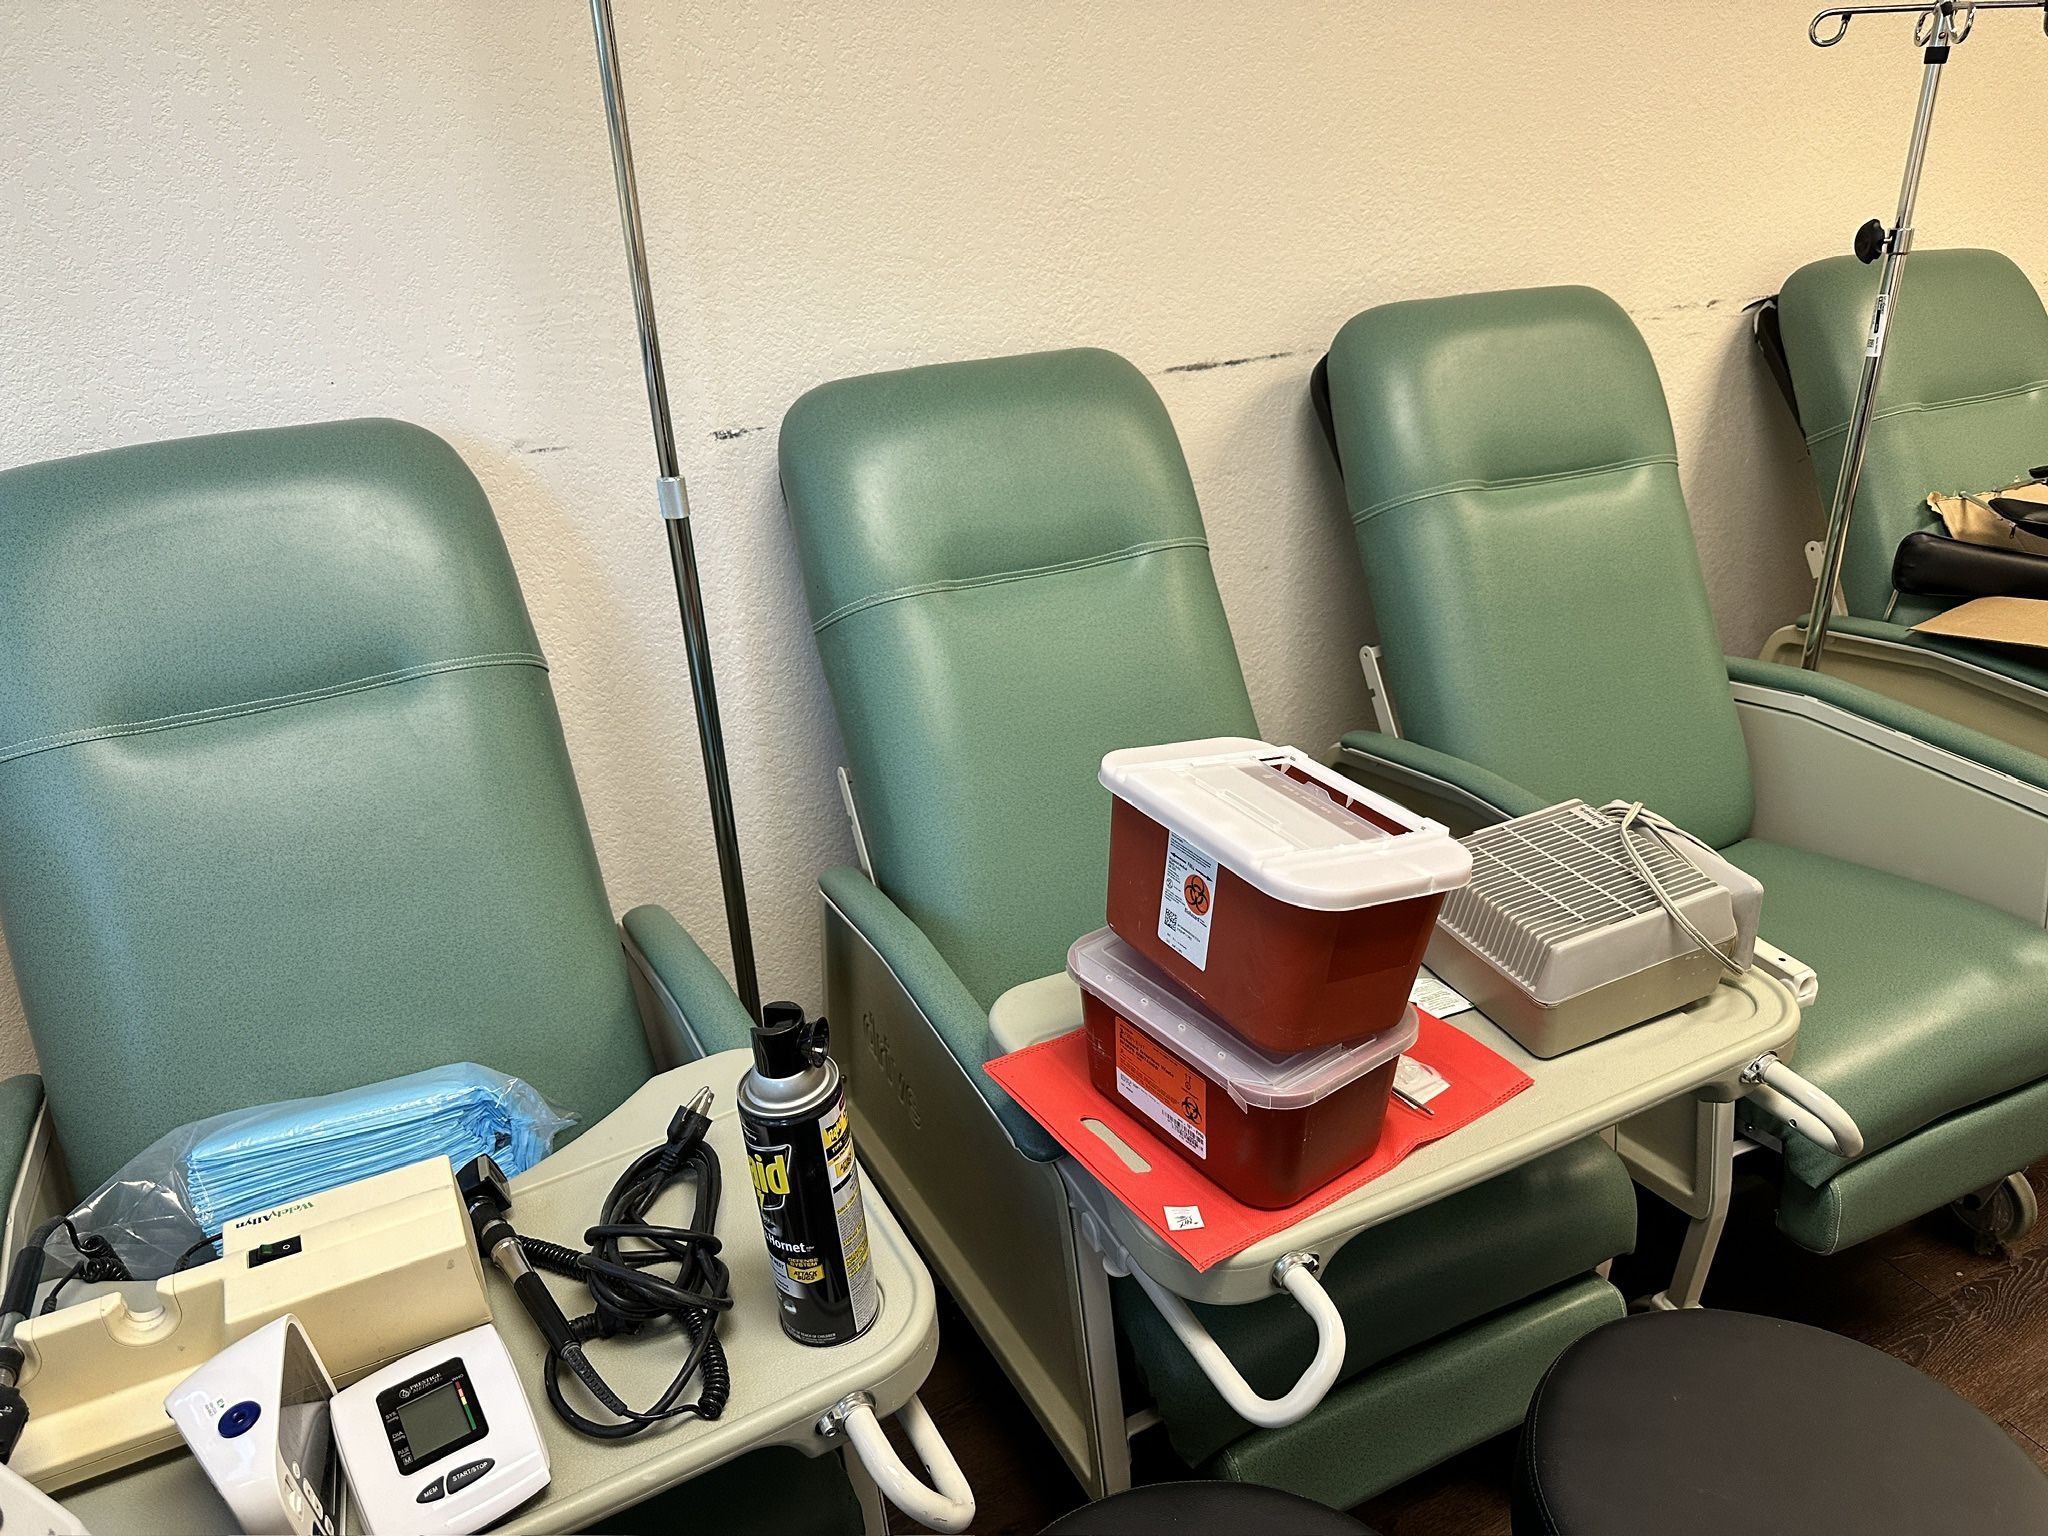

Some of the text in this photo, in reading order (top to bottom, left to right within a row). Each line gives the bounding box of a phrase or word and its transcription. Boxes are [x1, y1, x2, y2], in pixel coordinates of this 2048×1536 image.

[747, 1153, 790, 1195] aid
[768, 1233, 807, 1253] Hornet
[409, 1372, 442, 1390] PRESTIGE
[452, 1461, 488, 1482] START/STOP
[423, 1485, 438, 1498] MEM
